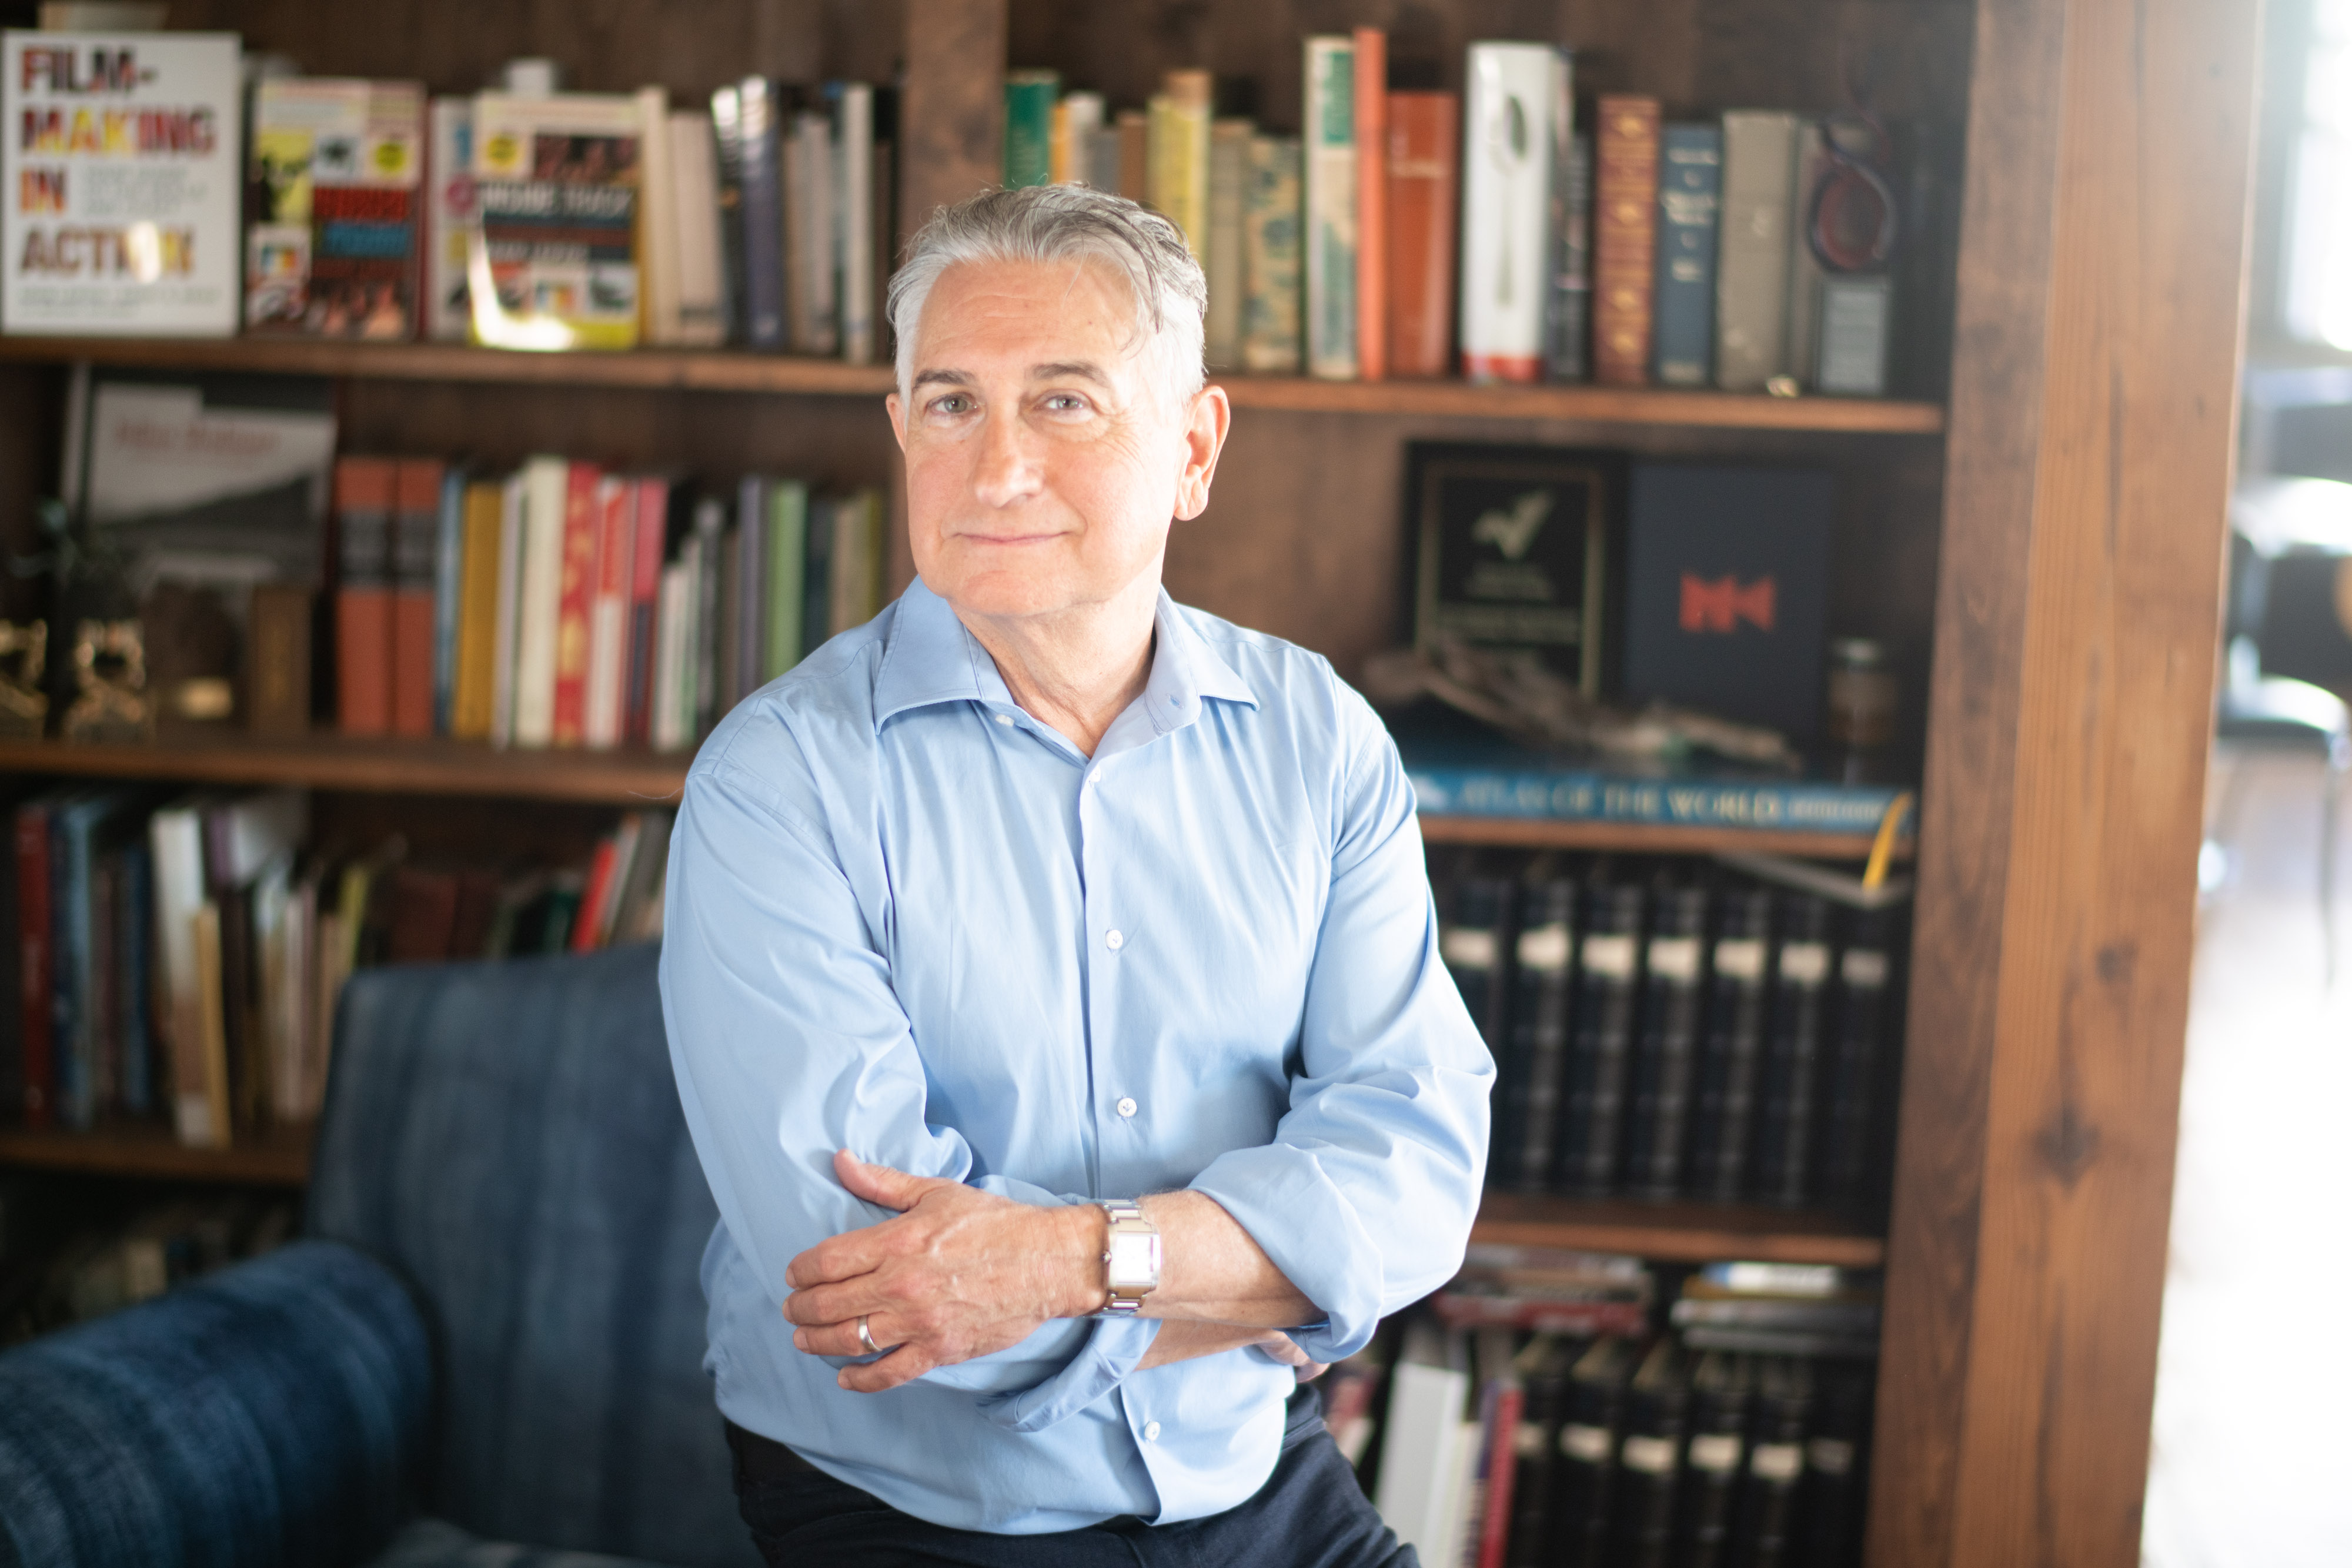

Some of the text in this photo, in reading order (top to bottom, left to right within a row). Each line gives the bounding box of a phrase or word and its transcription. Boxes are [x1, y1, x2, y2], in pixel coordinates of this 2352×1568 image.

[21, 47, 156, 95] FILM-
[21, 106, 215, 156] MAKING
[21, 166, 66, 216] IN
[21, 226, 195, 276] ACTIN
[1461, 774, 1548, 810] ATLAS
[1604, 783, 1659, 816] THE
[1668, 787, 1780, 822] WORLD
